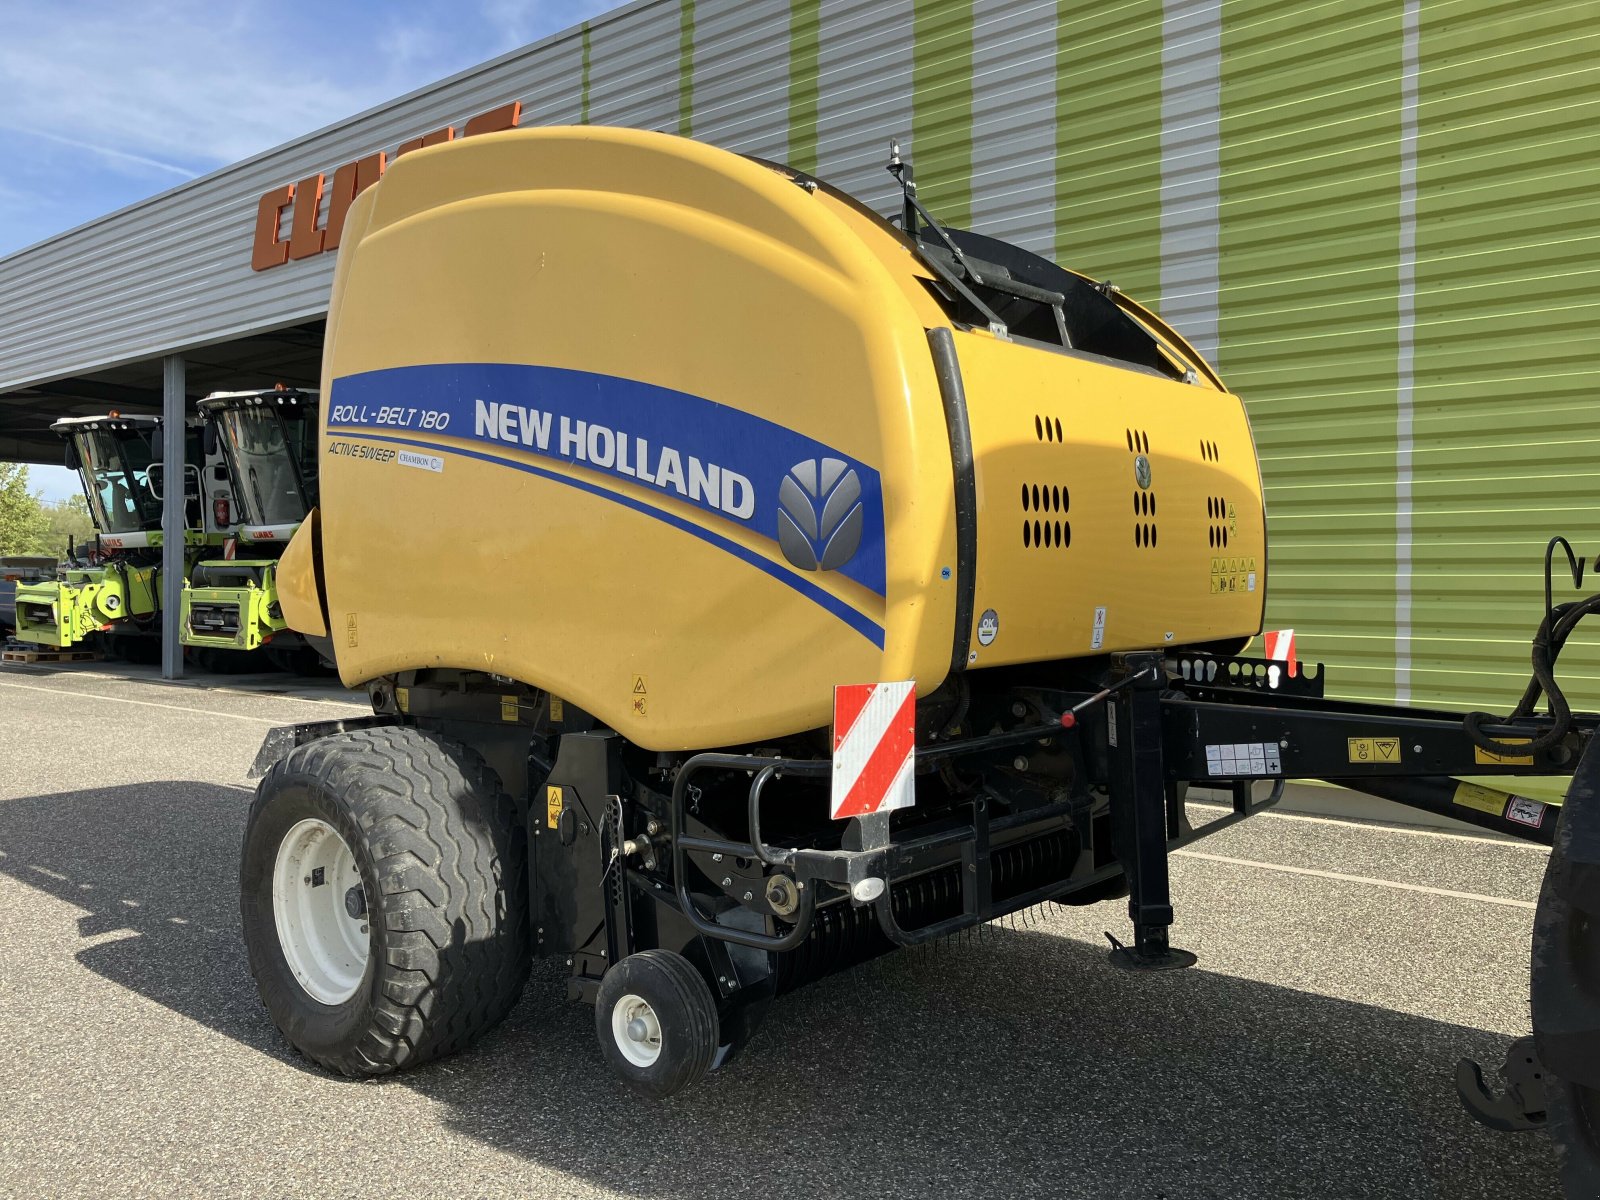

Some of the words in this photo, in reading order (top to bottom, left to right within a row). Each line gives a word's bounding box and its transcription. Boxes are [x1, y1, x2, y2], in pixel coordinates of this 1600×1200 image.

[251, 101, 521, 272] CLA
[418, 409, 450, 430] 180
[400, 453, 428, 466] CHAMBON
[475, 399, 552, 450] NEW
[560, 415, 755, 520] HOLLAND
[983, 618, 995, 629] OK
